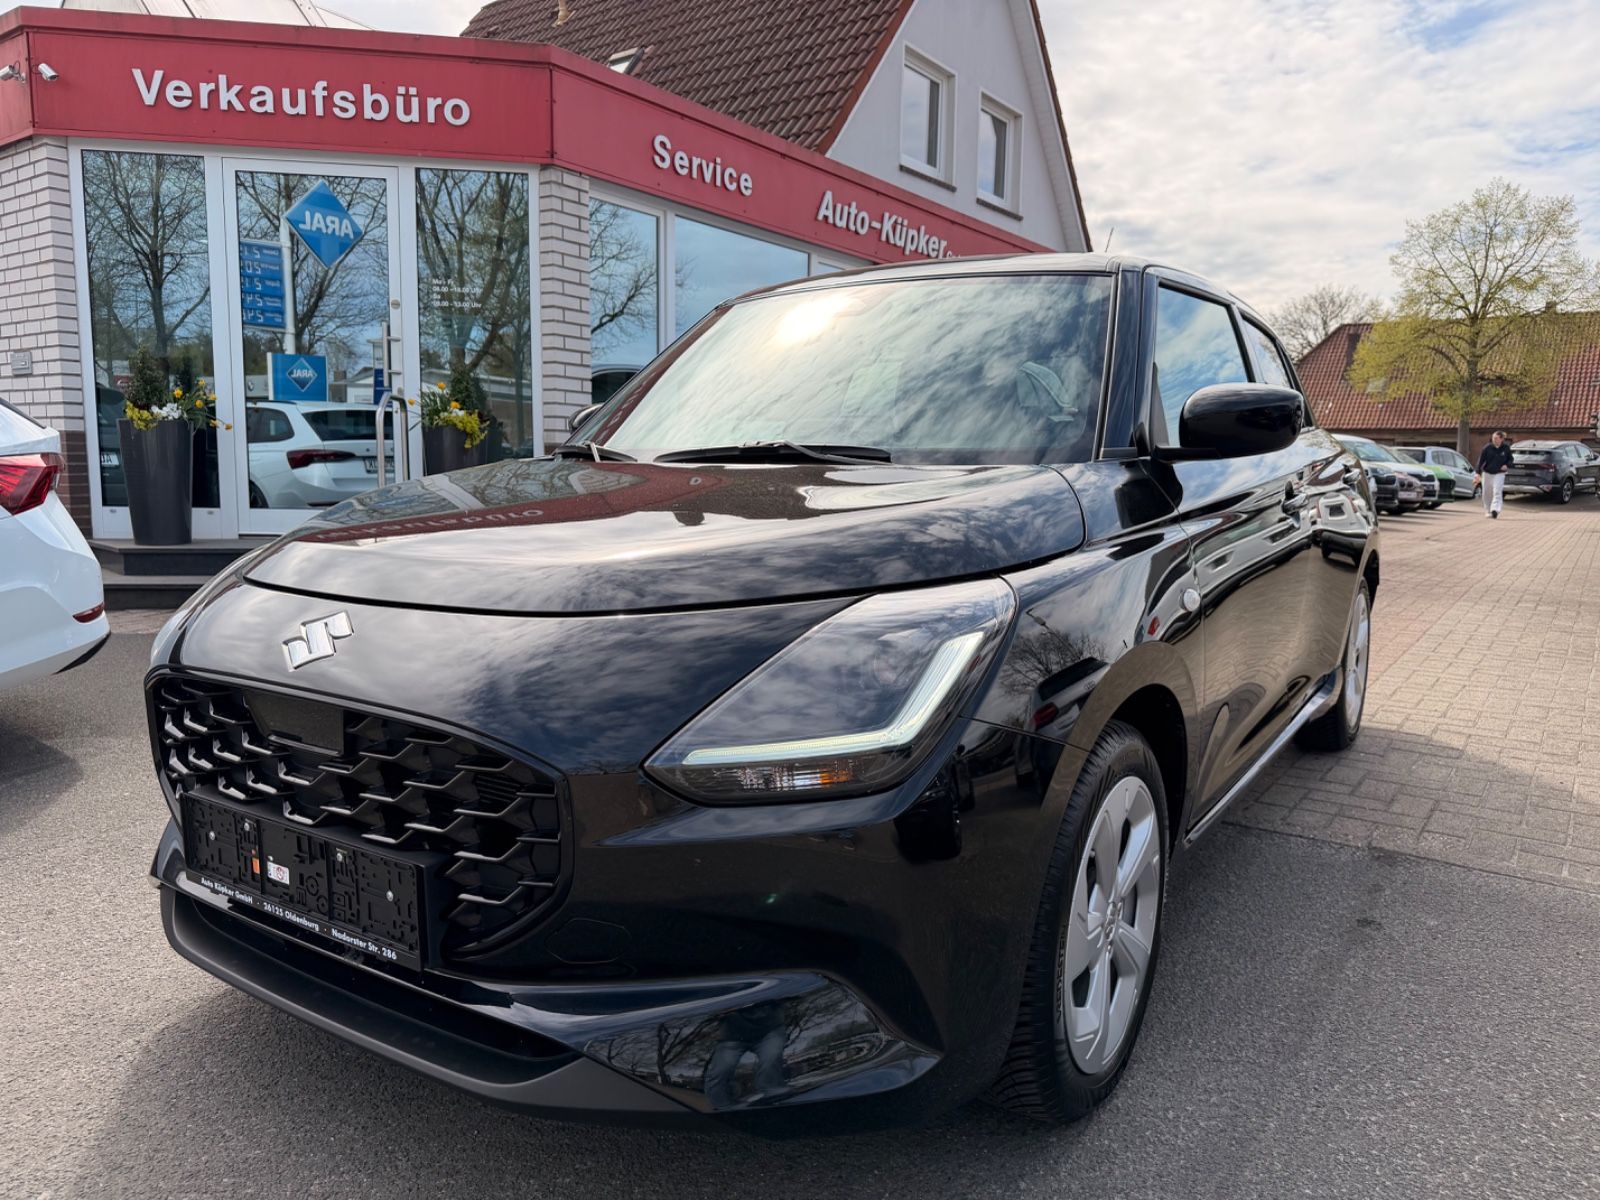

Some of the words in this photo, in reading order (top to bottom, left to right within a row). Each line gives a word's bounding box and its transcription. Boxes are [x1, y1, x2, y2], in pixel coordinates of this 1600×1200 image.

[131, 68, 470, 126] Verkaufsbüro
[653, 134, 753, 196] Service
[816, 190, 948, 259] Auto-Küpker
[201, 877, 214, 888] Auto
[235, 890, 253, 904] GmbH
[285, 910, 320, 932] Oldenburg
[368, 942, 381, 954] Str.
[382, 947, 397, 960] 286
